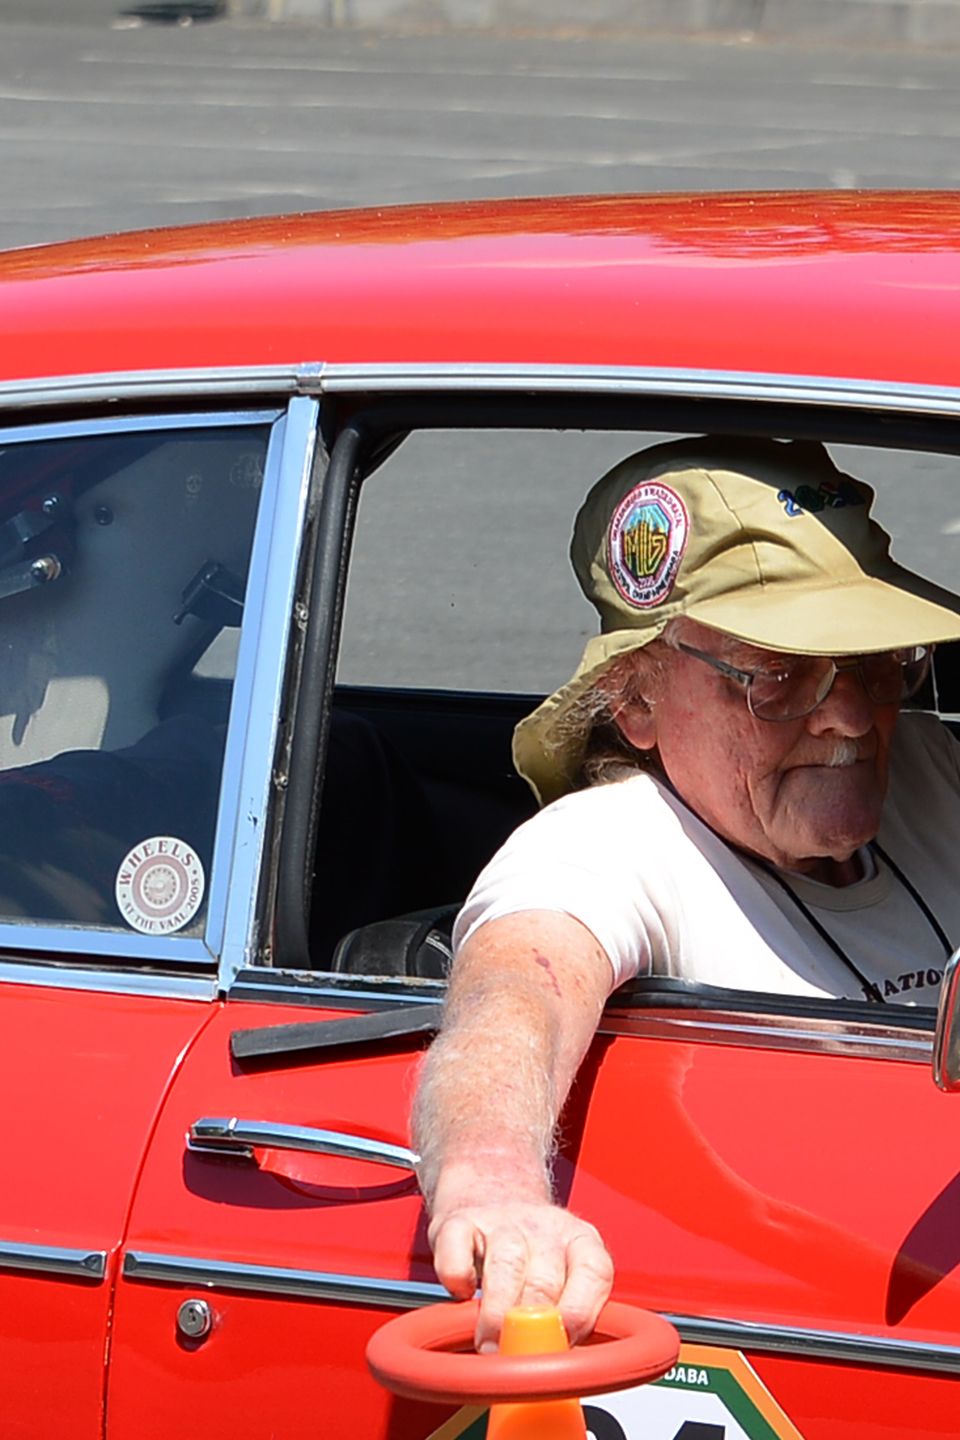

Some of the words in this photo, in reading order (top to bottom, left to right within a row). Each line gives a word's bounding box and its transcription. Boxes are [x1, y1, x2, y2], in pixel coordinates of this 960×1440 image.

[119, 840, 195, 886] WHEELS
[135, 916, 155, 931] THE
[159, 911, 188, 931] VAAL
[862, 968, 944, 1003] NATIO
